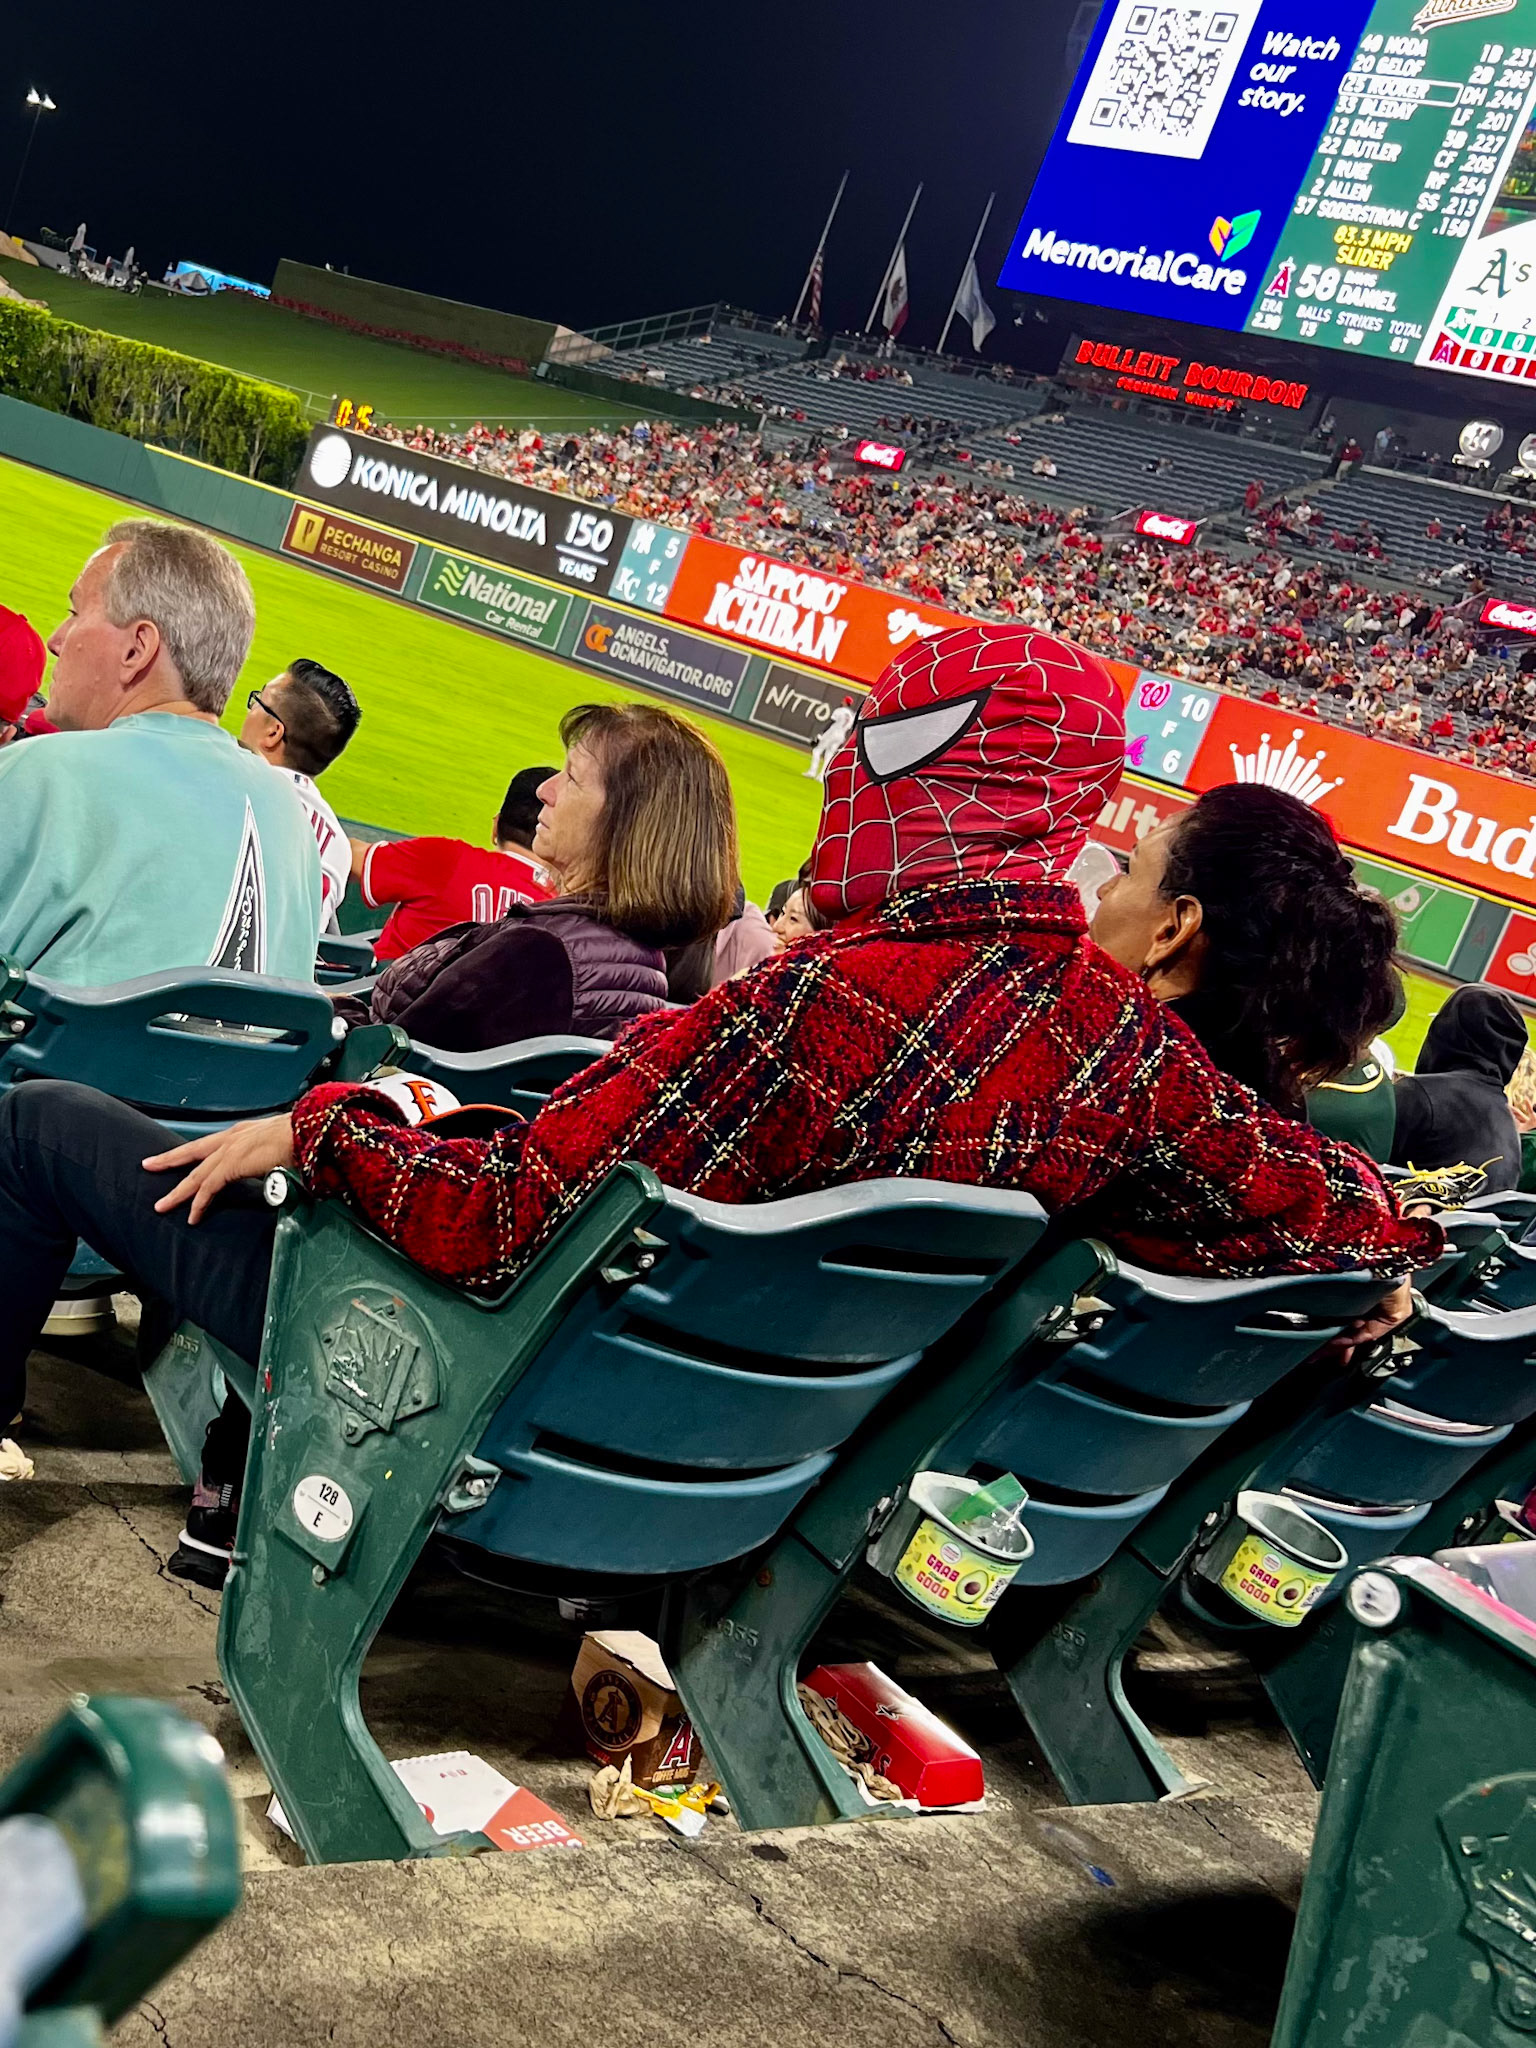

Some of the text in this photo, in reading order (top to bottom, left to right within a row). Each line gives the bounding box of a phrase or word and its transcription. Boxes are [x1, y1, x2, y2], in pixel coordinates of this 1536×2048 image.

[1262, 31, 1341, 61] Watch
[1384, 36, 1429, 57] NODA
[1250, 62, 1297, 83] our
[1351, 54, 1376, 73] 20
[1376, 56, 1425, 77] GELOF
[1238, 86, 1305, 117] story.
[1343, 77, 1523, 110] 25 ROOKER DH .244
[1451, 107, 1474, 126] LF
[1476, 111, 1514, 132] .201
[1329, 116, 1349, 135] 12
[1467, 133, 1506, 154] .227
[1318, 135, 1497, 174] 22 BUTLER CF .205
[1321, 157, 1332, 175] 1
[1424, 170, 1450, 190] RF
[1450, 175, 1487, 196] .254
[1310, 178, 1480, 217] 2 ALLEN SS .213
[1293, 195, 1319, 215] 37
[1317, 199, 1409, 228] SODERSTROM
[1407, 211, 1423, 231] C
[1333, 225, 1413, 254] 83.3 MPH
[1022, 228, 1247, 295] MemorialCare
[1335, 245, 1394, 271] SLIDER
[1295, 263, 1341, 301] 58
[1335, 284, 1398, 313] DANIEL
[1259, 298, 1423, 339] ERA BALLS STRIKES TOTAL
[1492, 313, 1532, 329] 1 2
[1480, 328, 1494, 346] 0
[1511, 334, 1527, 351] 0
[1074, 340, 1309, 410] BULLEIT BOURBON
[1470, 351, 1485, 368] 0
[1502, 356, 1517, 374] 0
[351, 455, 548, 547] KONICA MINOLTA
[324, 525, 402, 567] PECHANGA
[565, 510, 614, 553] 150
[320, 543, 399, 580] RESORT CASINO
[665, 537, 680, 559] 5
[558, 556, 598, 584] YEARS
[648, 559, 662, 575] F
[460, 570, 558, 625] National
[616, 566, 669, 606] KC 12
[733, 557, 845, 614] SAPPORO
[485, 610, 543, 638] Car Rental
[703, 582, 848, 663] ICHIBAN
[614, 624, 670, 657] ANGELS.
[609, 641, 734, 698] OCNAVIGATOR.ORG
[765, 684, 831, 722] NITTO
[1181, 694, 1210, 722] 10
[1161, 719, 1178, 738] F
[1162, 749, 1182, 774] 6
[1387, 774, 1536, 880] Bud
[401, 1080, 438, 1120] F
[318, 1483, 339, 1506] 128
[313, 1512, 324, 1528] E
[926, 1554, 960, 1582] GRAB
[1249, 1563, 1280, 1589] GRAB
[916, 1570, 950, 1599] GOOD
[1240, 1578, 1271, 1604] GOOD
[652, 1769, 675, 1783] COFFEE
[500, 1820, 570, 1845] BEER
